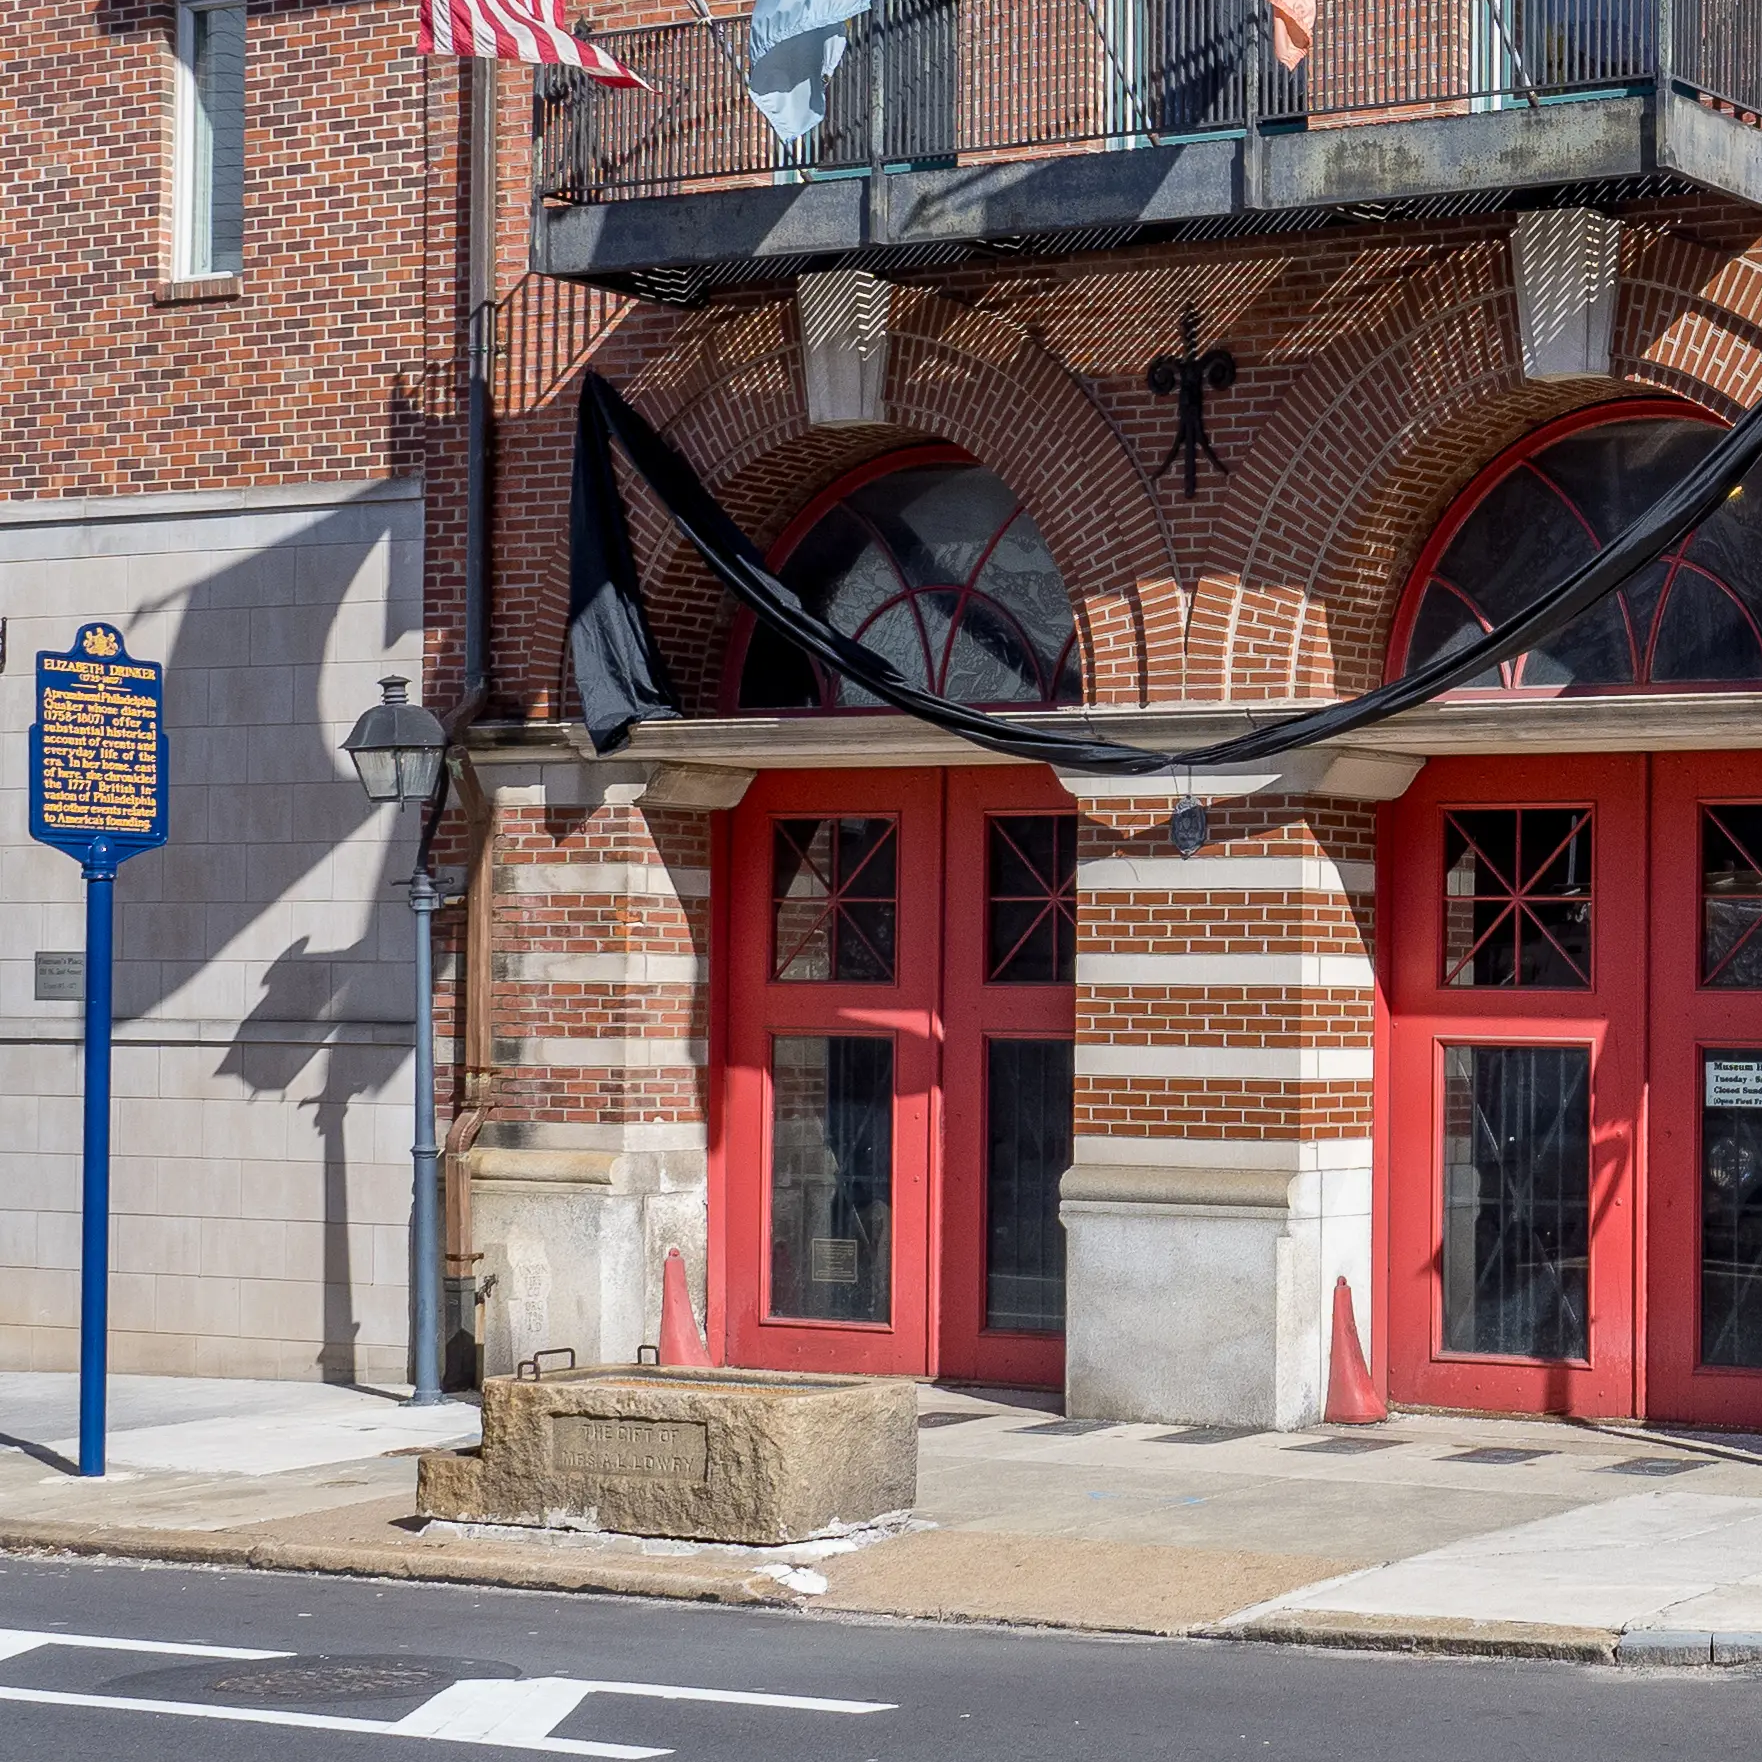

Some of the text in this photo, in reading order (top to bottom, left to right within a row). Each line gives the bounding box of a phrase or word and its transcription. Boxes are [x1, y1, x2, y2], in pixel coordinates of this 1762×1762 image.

[44, 658, 156, 680] ELIZABETH DRINKER
[44, 687, 157, 708] A prominent Philadelphia
[44, 698, 157, 718] Quaker whose diaries
[112, 717, 142, 728] offer
[43, 722, 156, 740] substantial historical
[43, 735, 157, 751] account of events and
[43, 746, 157, 763] everyday life of the
[69, 757, 81, 768] In
[82, 758, 101, 769] her
[43, 767, 57, 777] of
[86, 770, 103, 781] she
[104, 771, 157, 785] chronicled
[43, 779, 62, 789] the
[67, 779, 92, 791] 1777
[98, 781, 136, 794] British
[43, 791, 157, 807] vasion of Philadelphia
[43, 801, 157, 818] and other events related
[43, 812, 56, 823] to
[1713, 1062, 1754, 1072] Museum
[1714, 1075, 1748, 1084] Tuesday
[1713, 1086, 1740, 1095] Closed
[1713, 1098, 1734, 1106] (Open
[1735, 1098, 1752, 1106] First
[581, 1423, 680, 1445] THE GIFT OF
[633, 1454, 694, 1472] LOWRY
